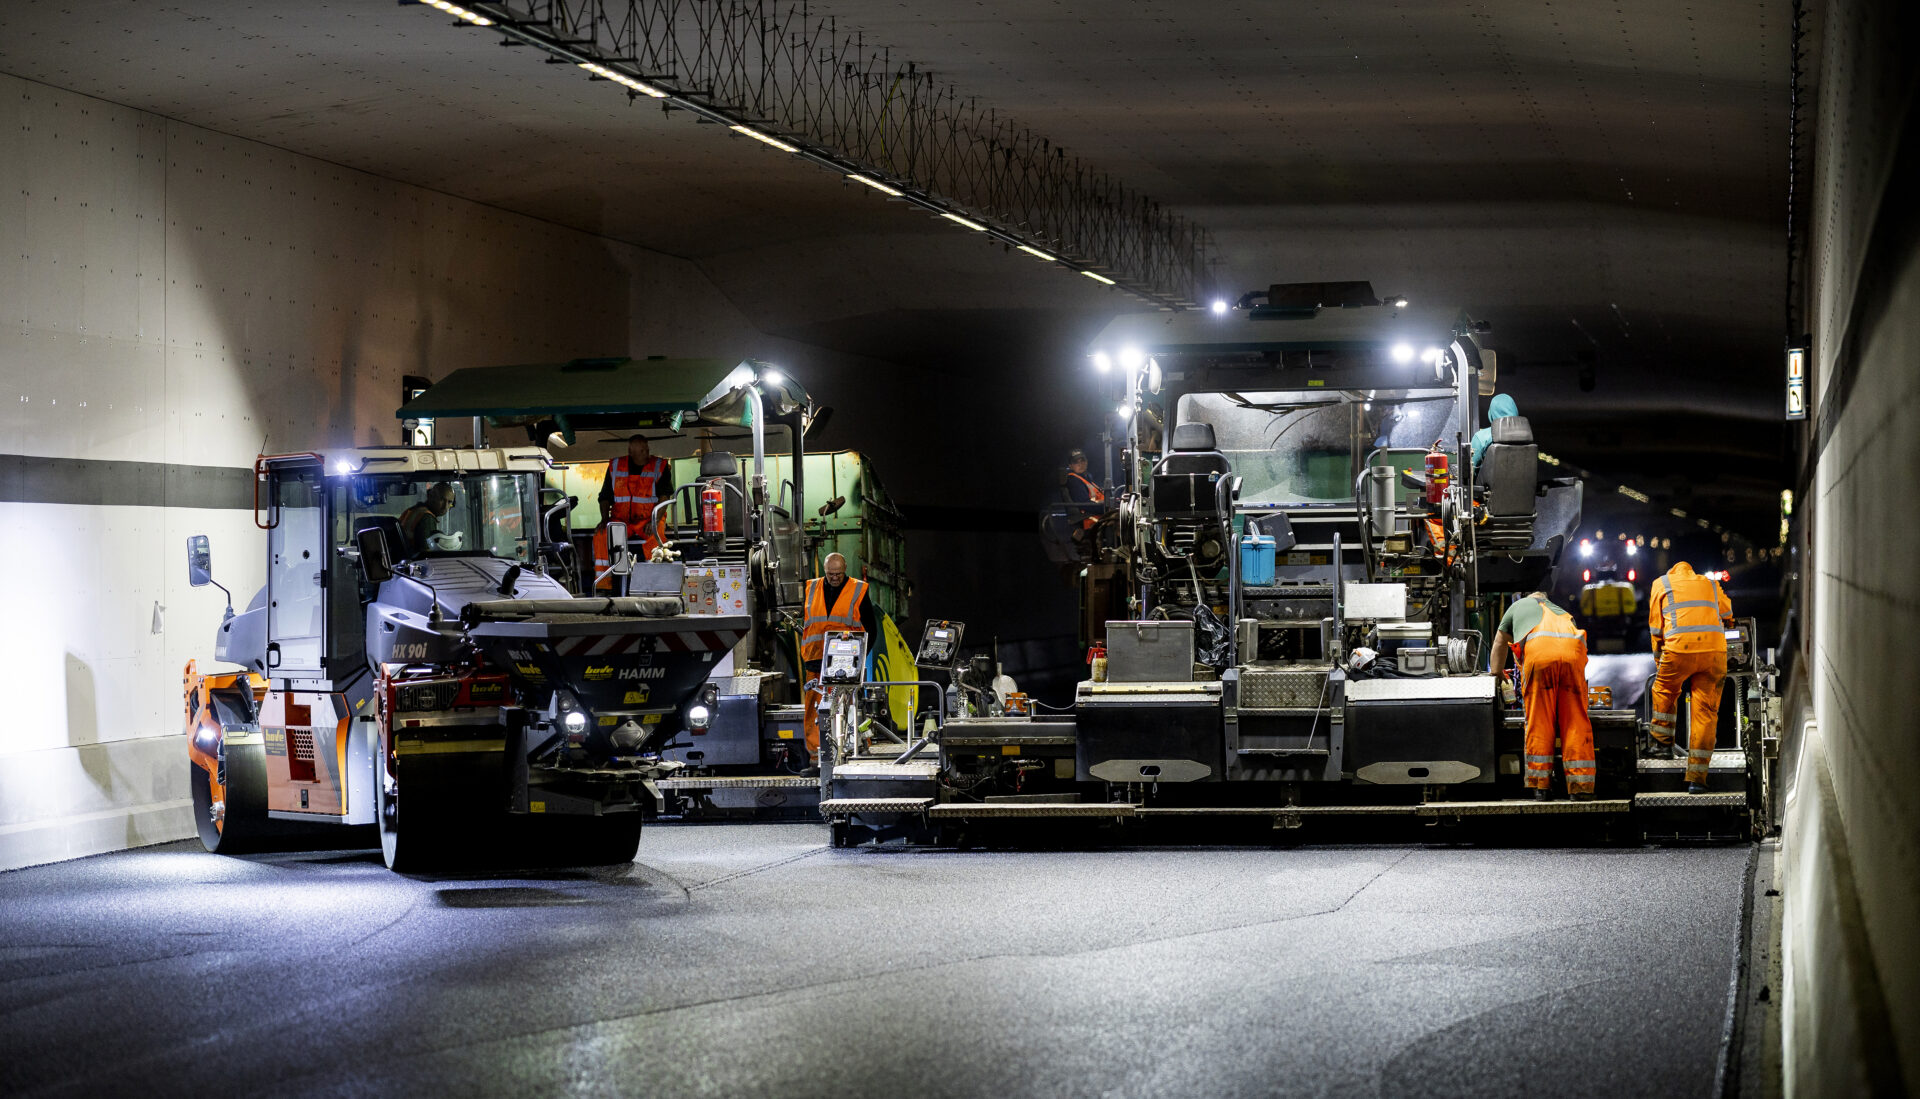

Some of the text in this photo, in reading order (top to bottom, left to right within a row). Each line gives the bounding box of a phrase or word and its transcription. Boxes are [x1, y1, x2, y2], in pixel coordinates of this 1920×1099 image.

[391, 642, 428, 659] HX 90i
[618, 667, 666, 680] HAMM
